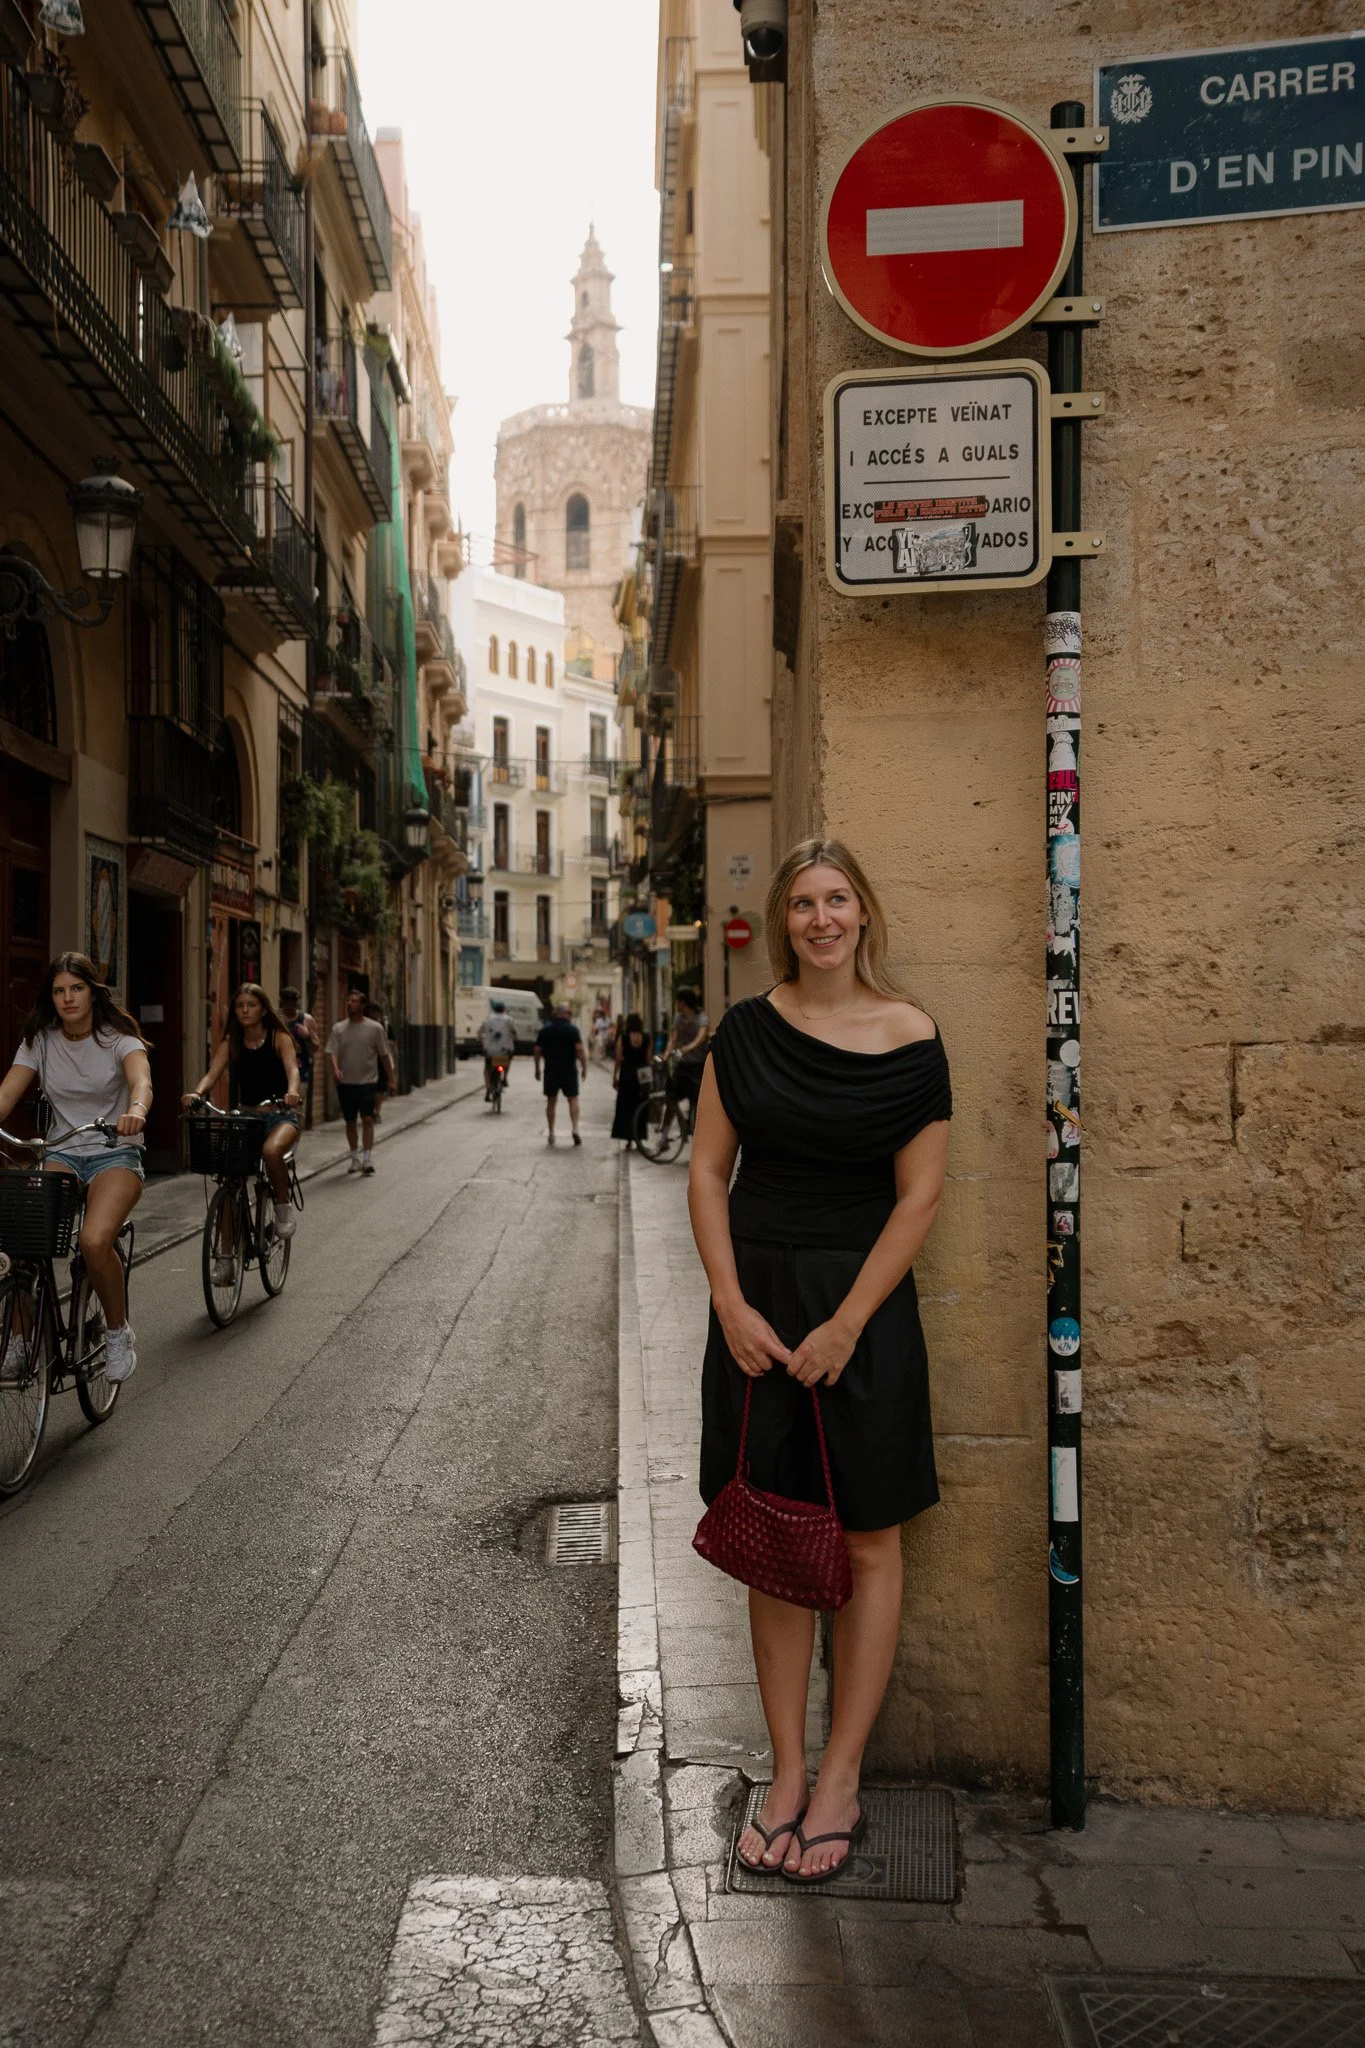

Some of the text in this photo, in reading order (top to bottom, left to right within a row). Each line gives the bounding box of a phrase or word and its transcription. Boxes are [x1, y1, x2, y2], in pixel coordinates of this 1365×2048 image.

[1200, 61, 1356, 105] CARRER
[1170, 151, 1274, 193] D'EN
[863, 401, 1011, 426] EXCEPTE VEÏNAT
[849, 442, 1018, 466] I ACCÉS A GUALS
[843, 537, 852, 552] Y
